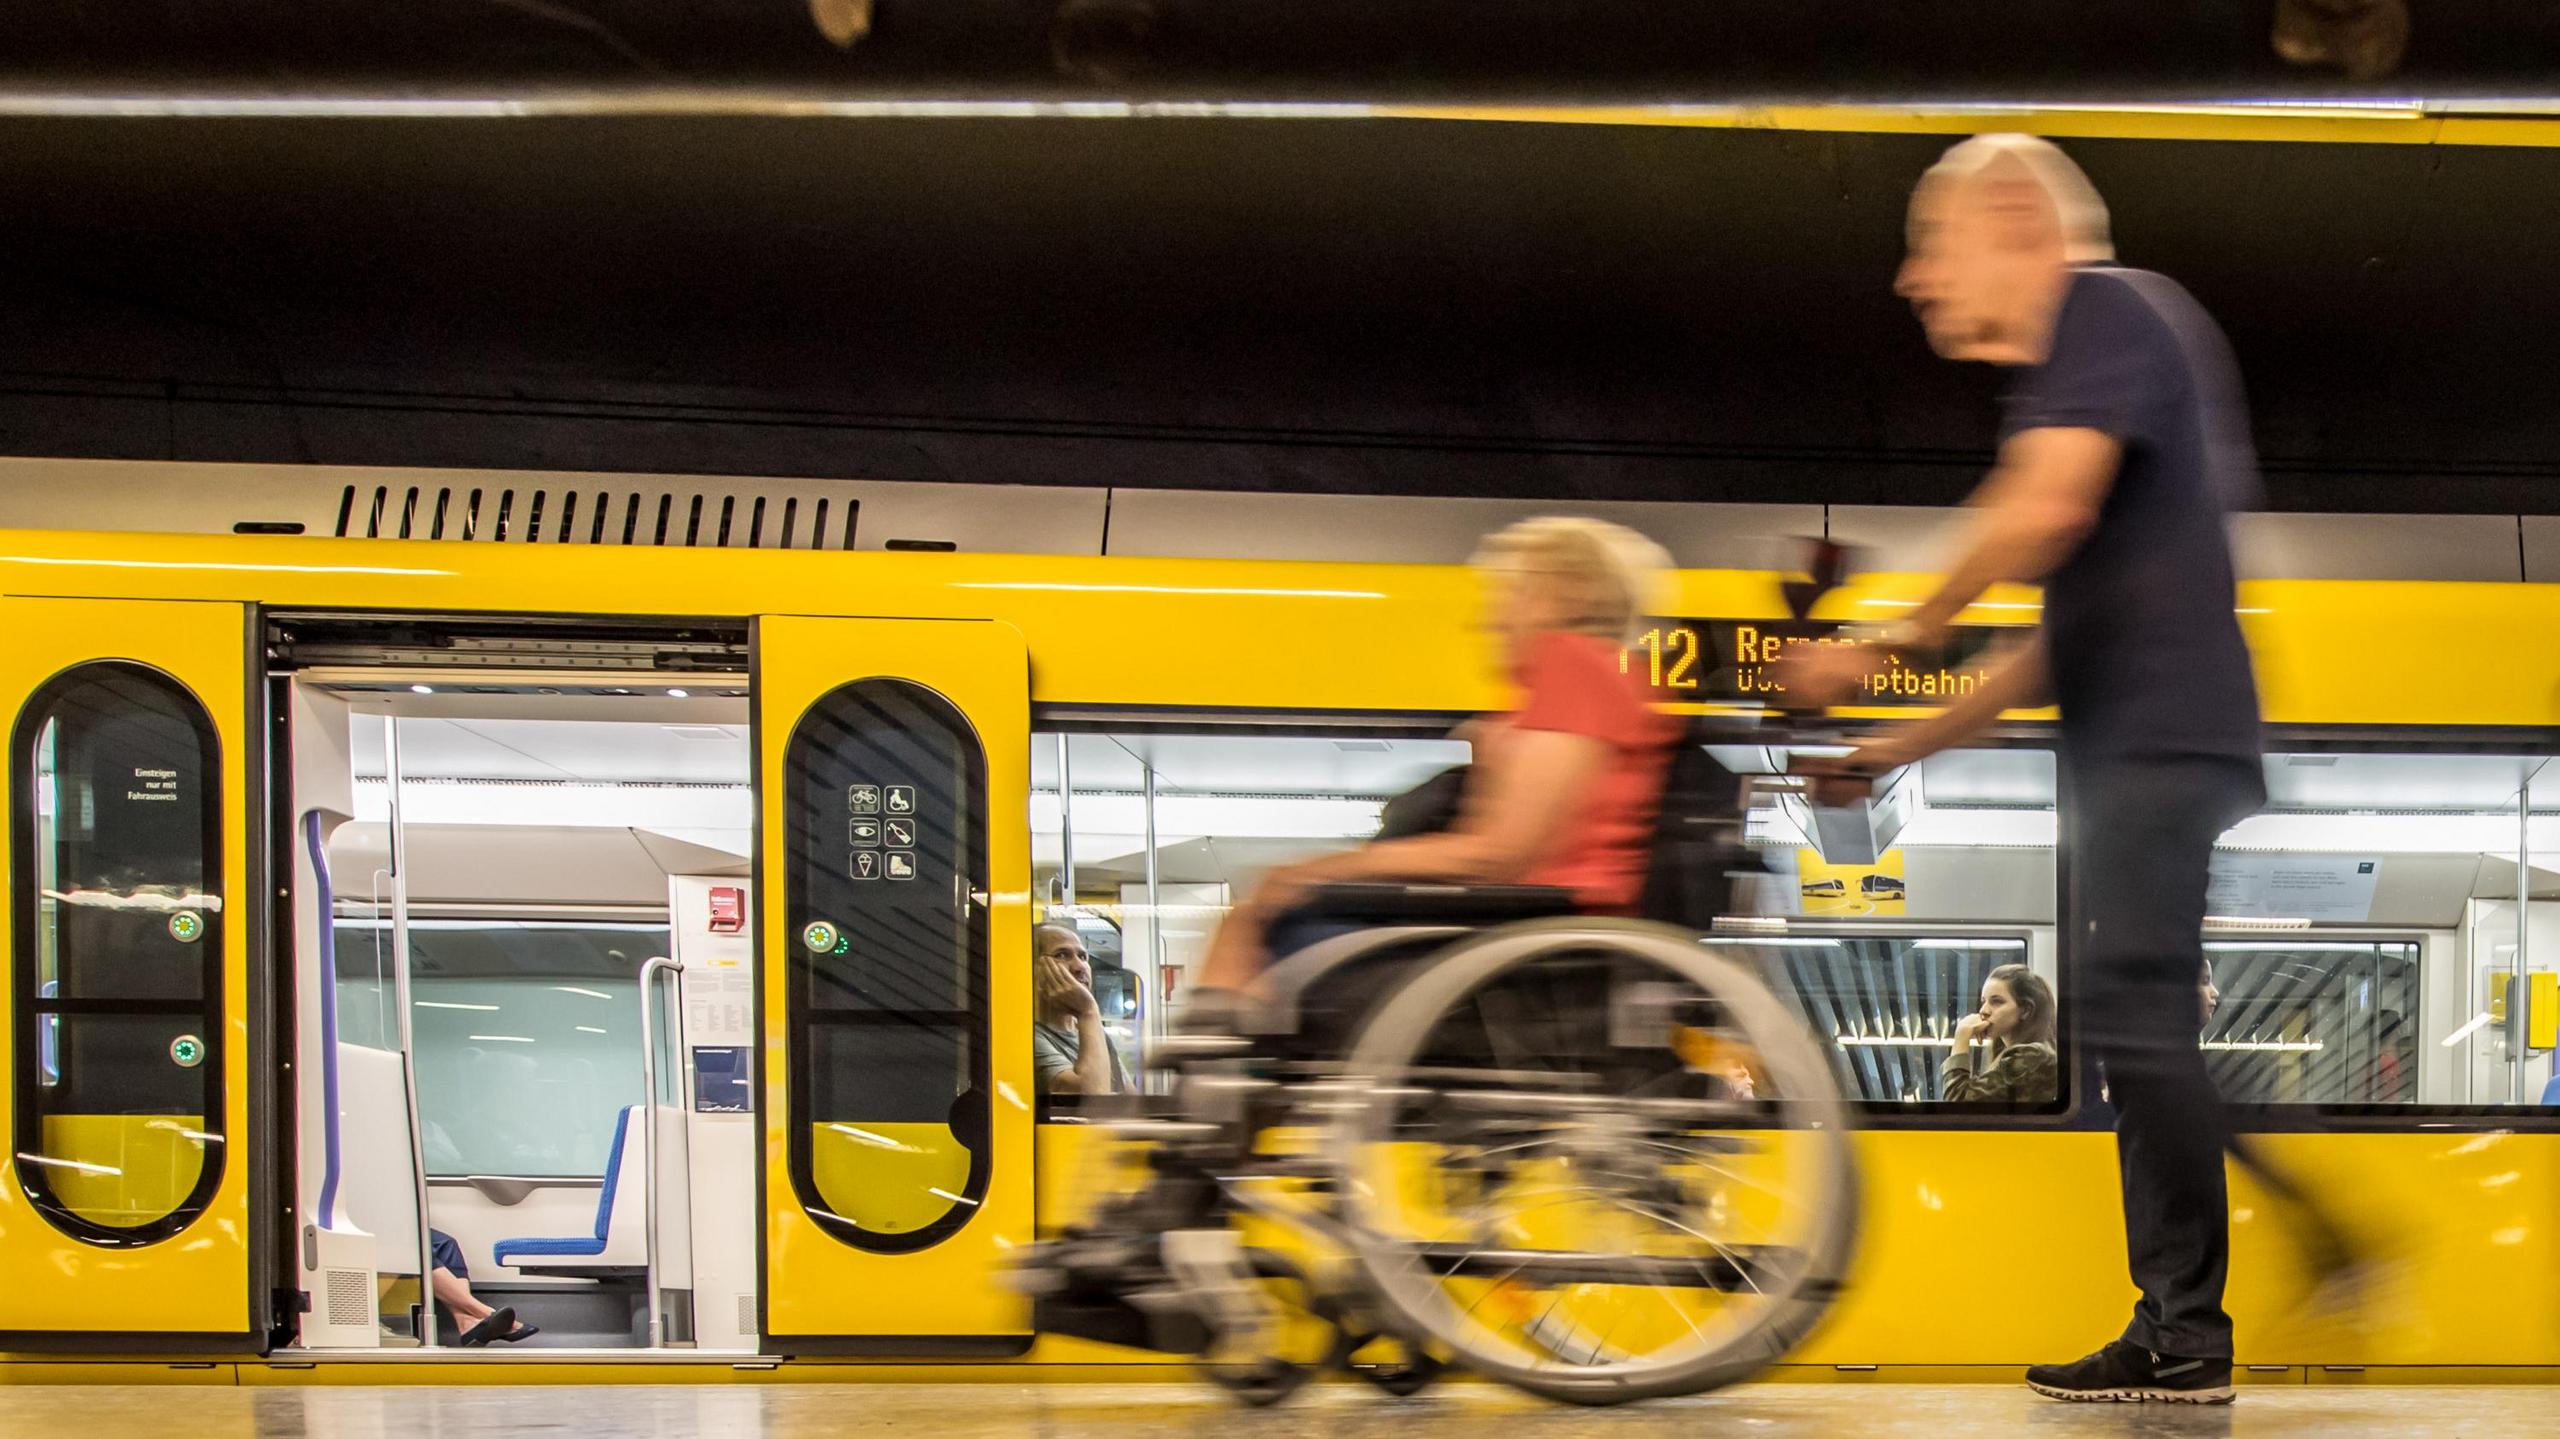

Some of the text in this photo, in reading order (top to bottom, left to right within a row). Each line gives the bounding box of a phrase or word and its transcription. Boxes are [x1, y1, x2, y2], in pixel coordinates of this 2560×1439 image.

[1619, 628, 1697, 687] 12
[135, 768, 176, 779] Einsteigen
[162, 781, 176, 789] mit
[128, 791, 177, 800] Fahrausweis
